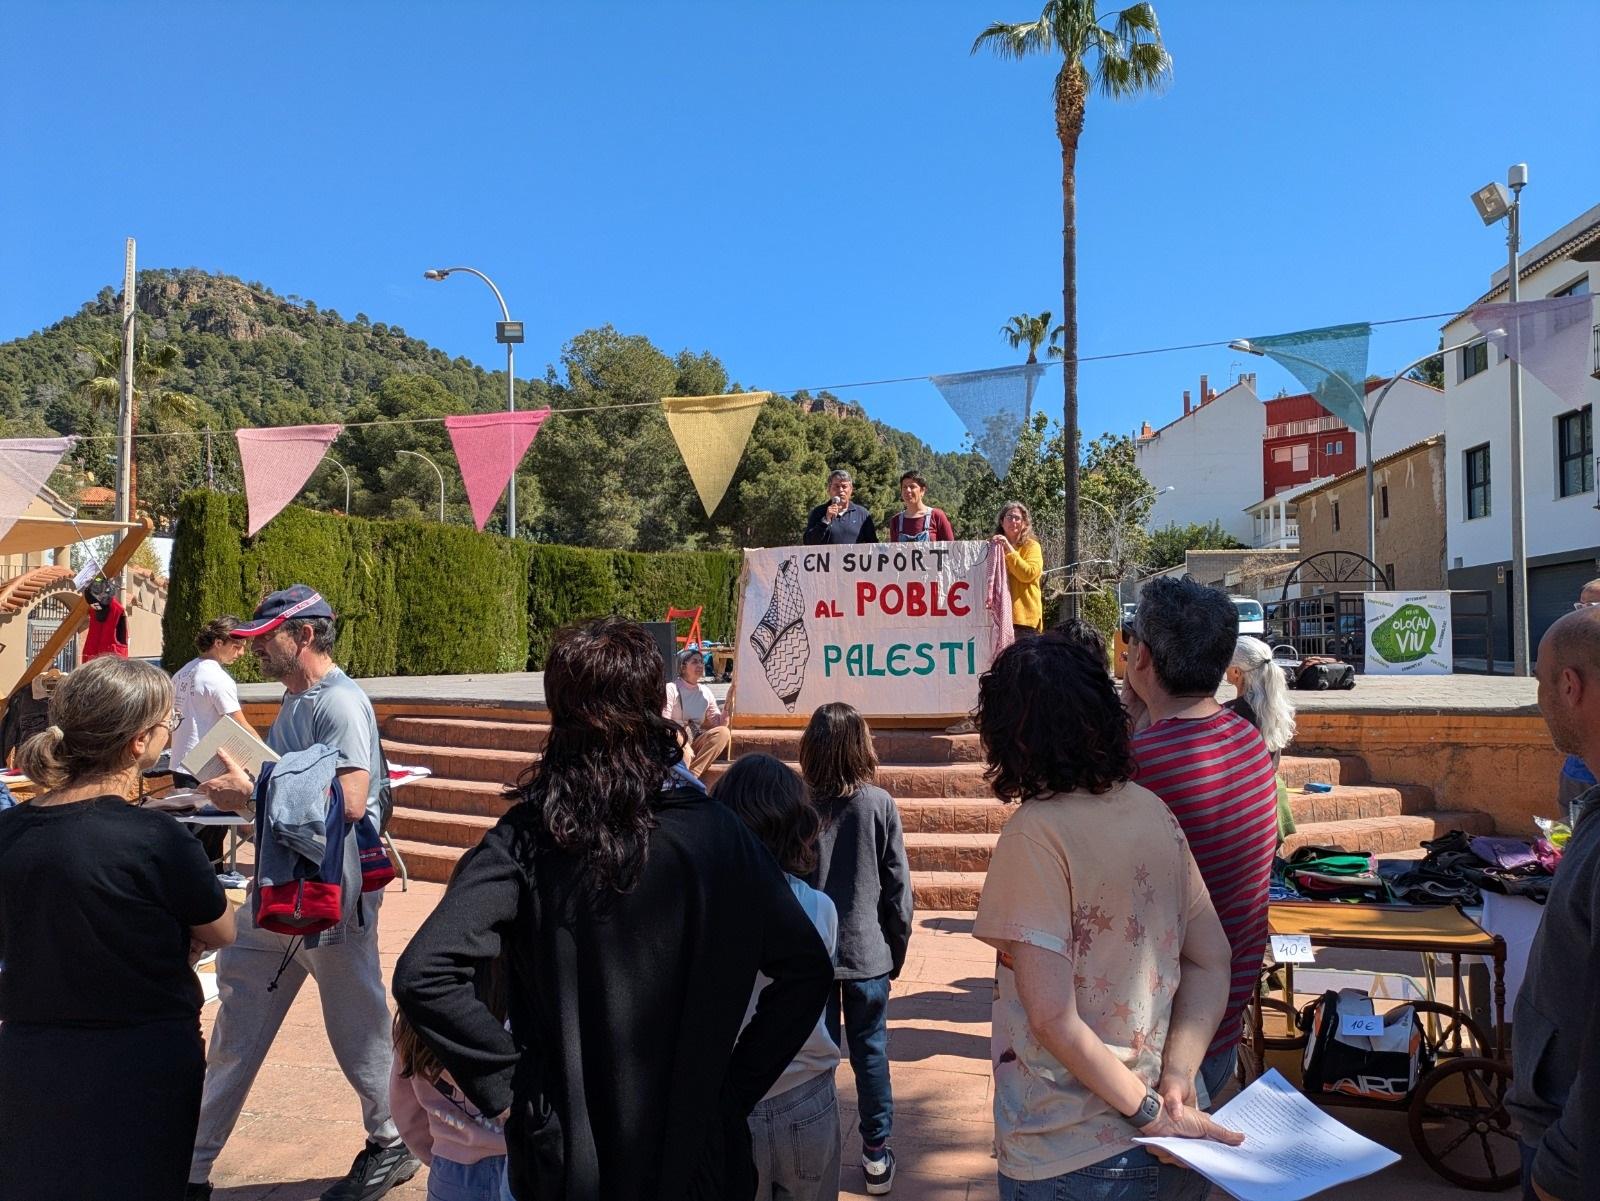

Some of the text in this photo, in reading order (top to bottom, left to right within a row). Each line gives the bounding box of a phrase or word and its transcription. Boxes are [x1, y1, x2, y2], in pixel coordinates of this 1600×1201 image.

[804, 549, 949, 572] EN SUPORT
[814, 581, 971, 618] AL POBLE
[824, 636, 976, 677] PALESTÍ
[1396, 630, 1426, 654] VIU
